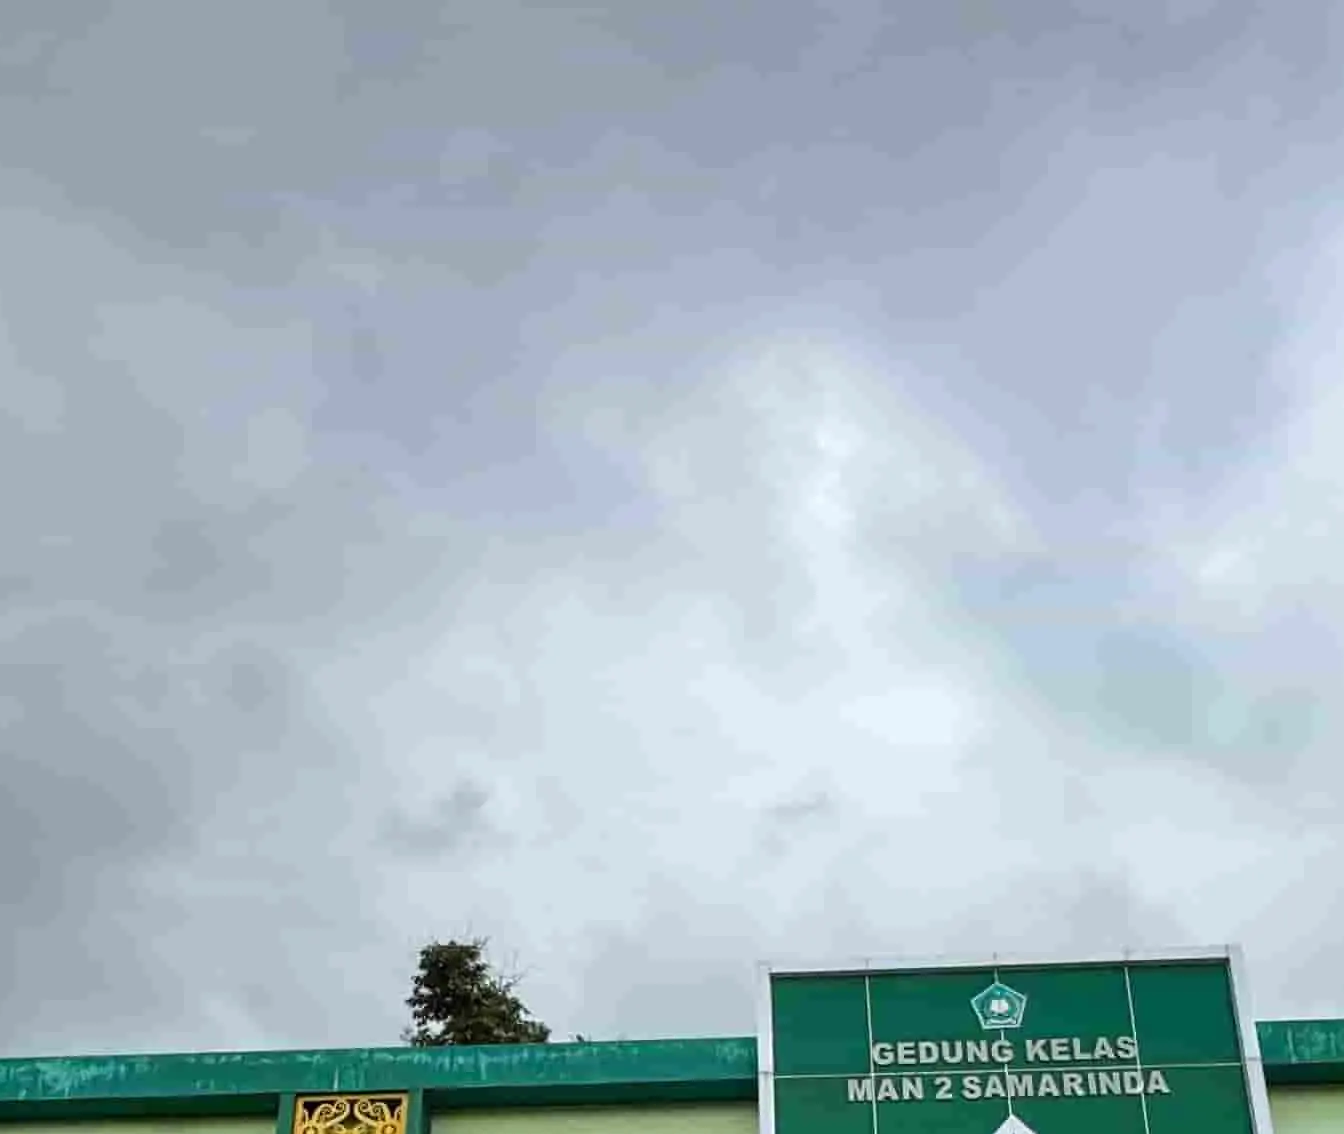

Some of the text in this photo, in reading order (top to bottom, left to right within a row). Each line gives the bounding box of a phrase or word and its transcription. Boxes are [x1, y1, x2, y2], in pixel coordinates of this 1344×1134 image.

[871, 1036, 1138, 1066] GEDUNG KELAS
[847, 1070, 1170, 1102] MAN 2 SAMARINDA
